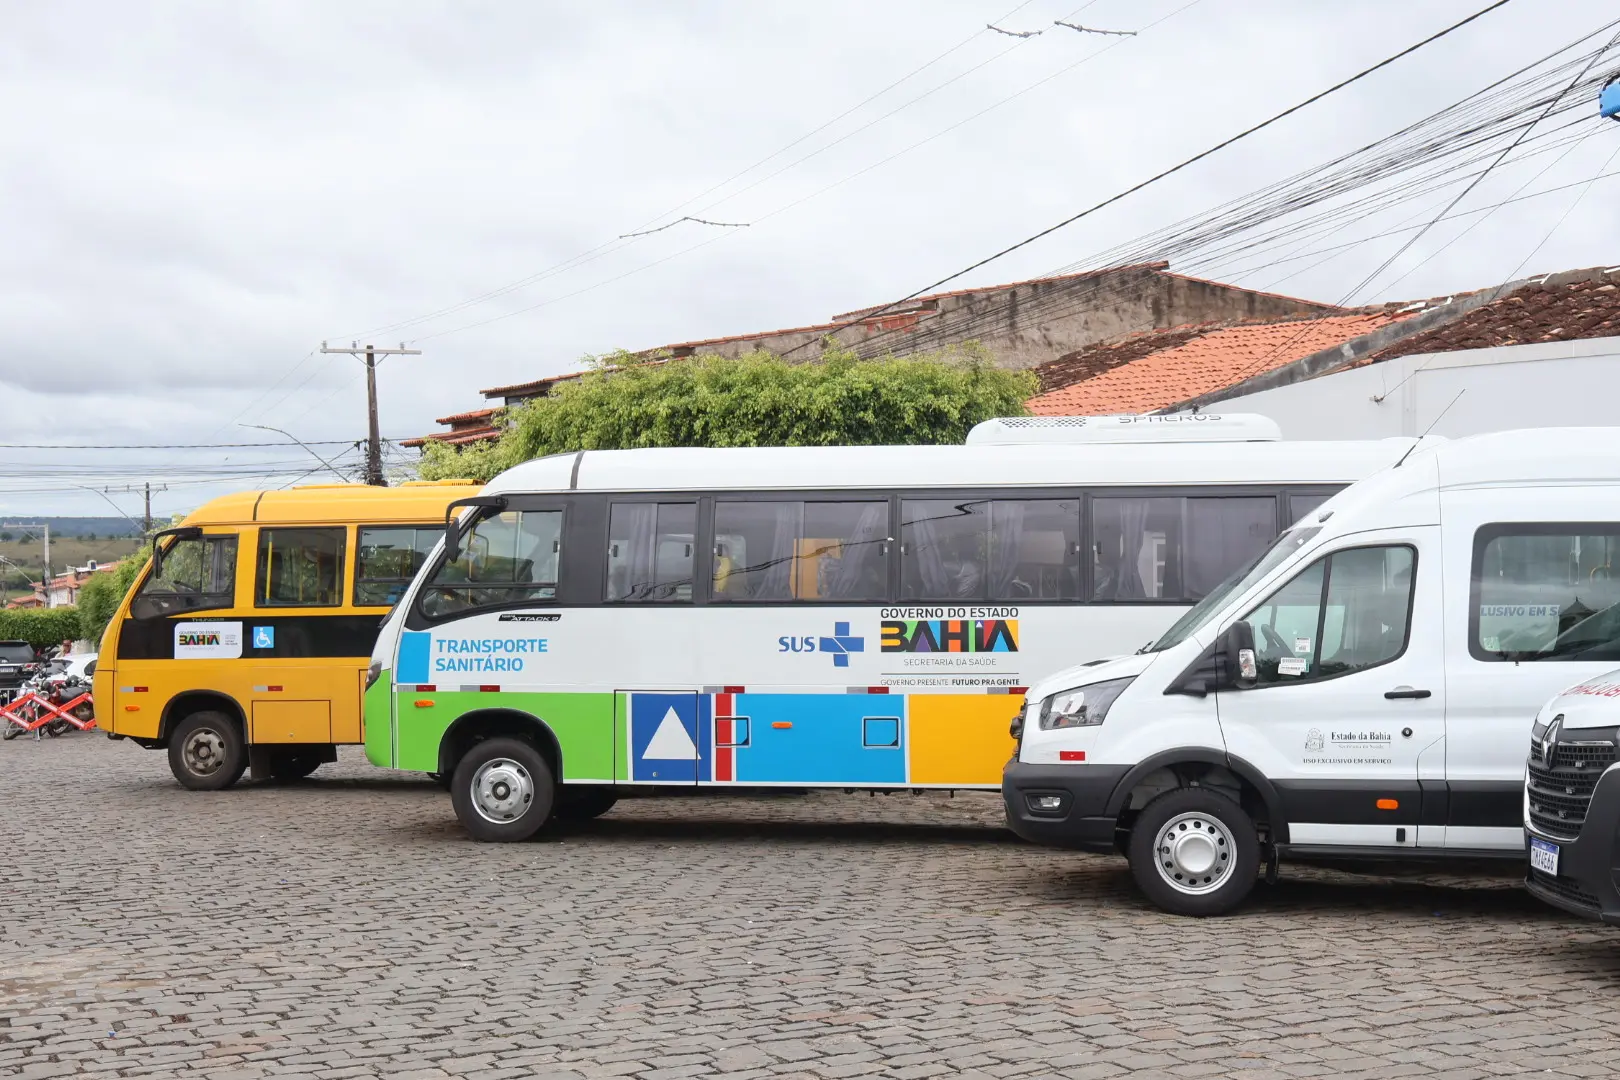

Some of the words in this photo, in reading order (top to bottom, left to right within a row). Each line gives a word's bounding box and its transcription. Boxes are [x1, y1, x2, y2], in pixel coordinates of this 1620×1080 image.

[1119, 415, 1221, 423] SPHEROS
[881, 608, 943, 618] GOVERNO
[948, 608, 965, 618] DO
[970, 607, 1019, 618] ESTADO
[1528, 606, 1546, 617] EM
[1549, 606, 1560, 617] S
[179, 635, 220, 645] BAHIA
[881, 620, 1019, 652] BAHIA
[436, 639, 548, 653] TRANSPORTE
[778, 636, 815, 652] SUS
[436, 654, 523, 672] SANITÁRIO
[969, 657, 996, 666] SAÚDE
[1331, 732, 1356, 740] Estado
[1358, 732, 1367, 740] da
[1369, 732, 1391, 740] Bahia
